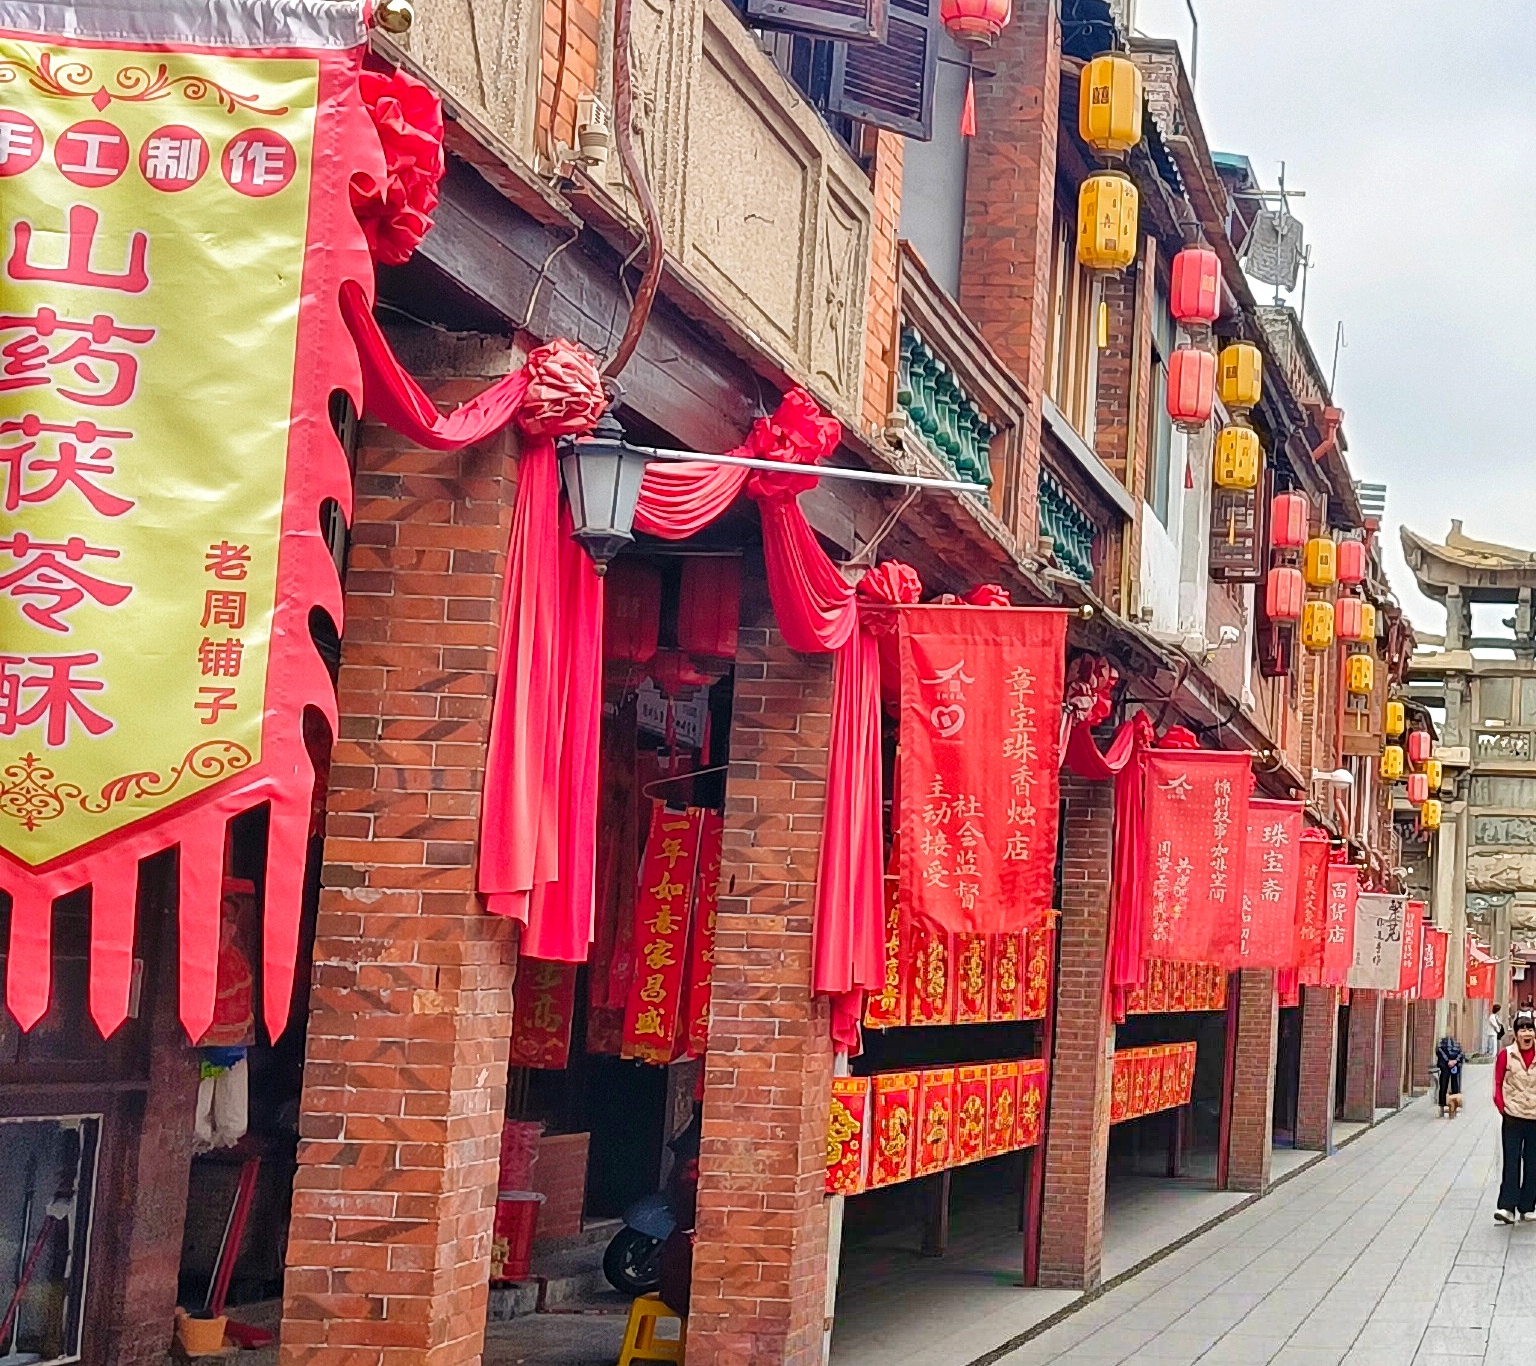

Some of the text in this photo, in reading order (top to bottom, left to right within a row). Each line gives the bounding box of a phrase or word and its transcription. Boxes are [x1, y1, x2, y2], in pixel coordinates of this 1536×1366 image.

[0, 204, 156, 746] 山药茯苓酥
[193, 540, 252, 726] 老周铺子
[1002, 666, 1039, 861] 章宝珠香烛店
[920, 774, 952, 888] 主动接受
[952, 795, 985, 910] 社会监督
[1261, 822, 1290, 903] 珠宝斋
[1327, 882, 1347, 944] 百货店
